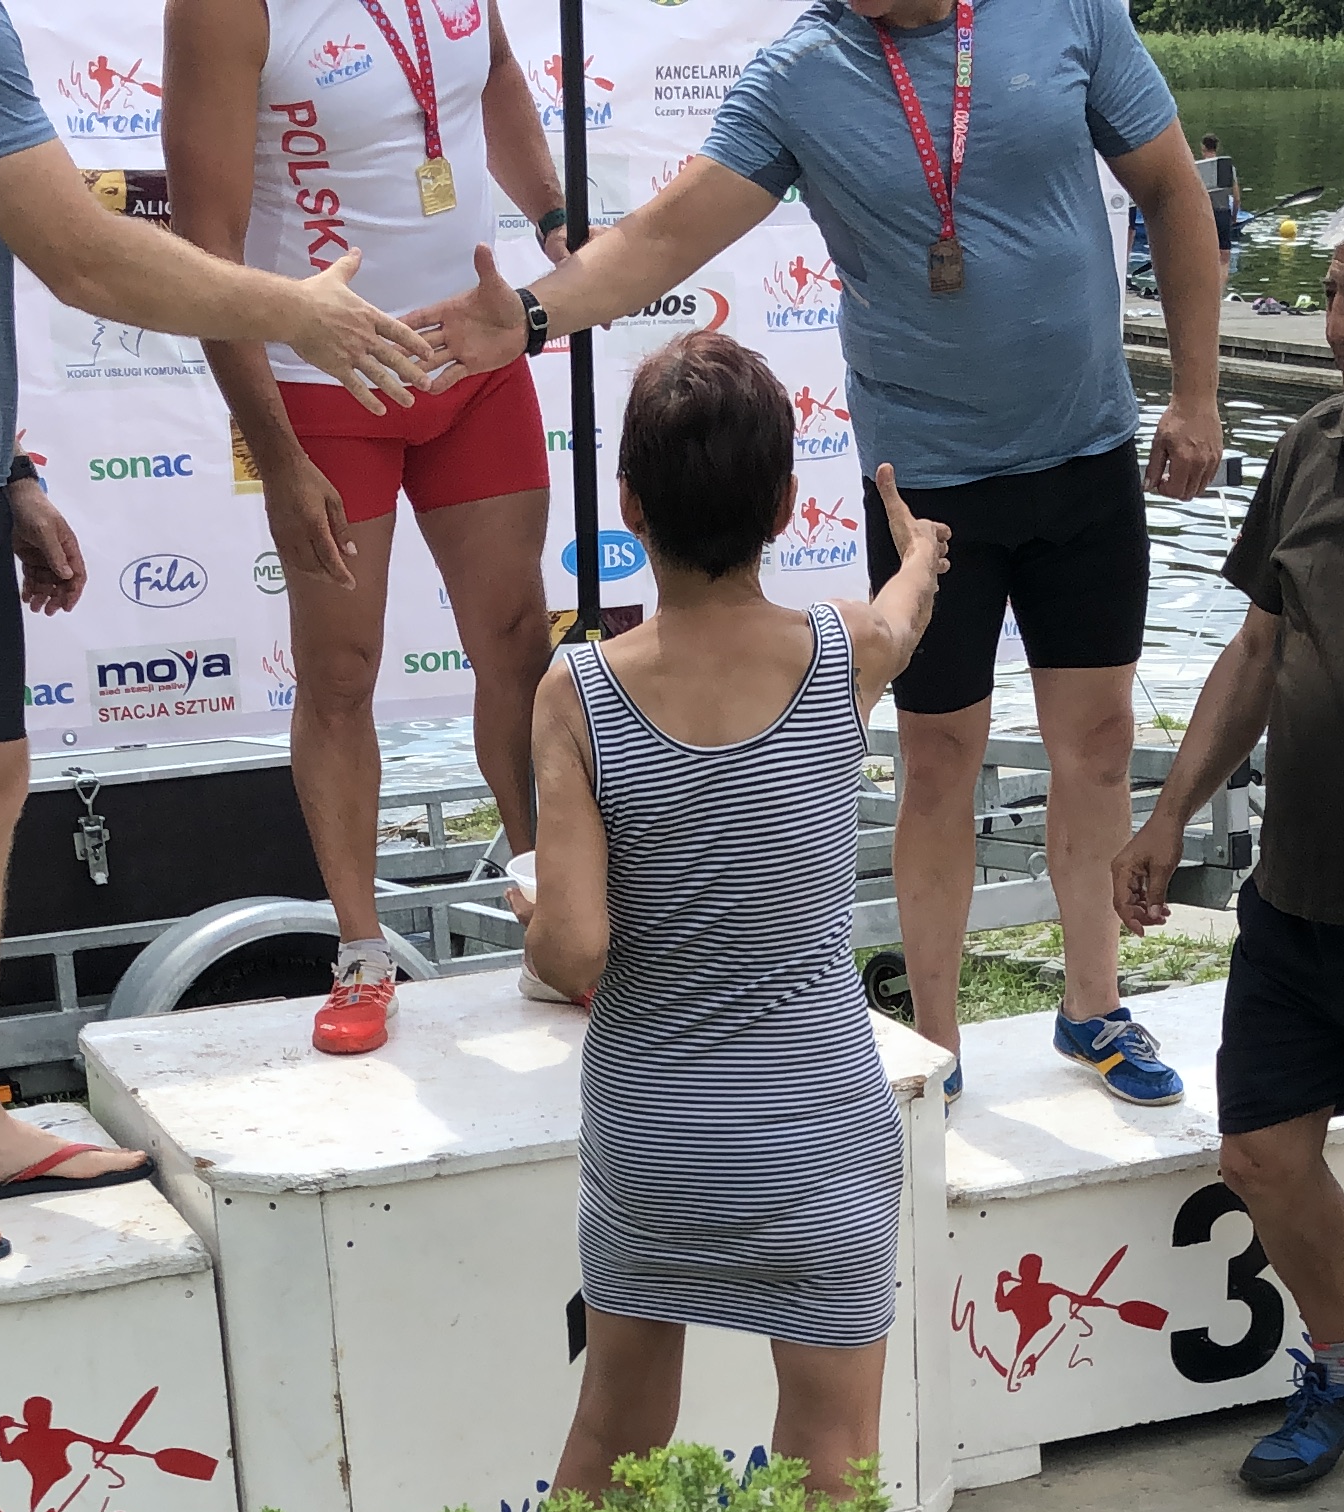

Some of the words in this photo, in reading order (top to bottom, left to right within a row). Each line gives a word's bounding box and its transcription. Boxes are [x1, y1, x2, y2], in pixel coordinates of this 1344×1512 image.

[656, 65, 741, 80] KANCELARIA
[655, 85, 732, 100] NOTARIALN
[67, 369, 101, 379] KOGUT
[144, 366, 205, 376] KOMUNALNE
[90, 454, 192, 481] sonac
[604, 542, 636, 569] BS
[97, 649, 231, 696] moya
[98, 703, 170, 722] STACJA
[174, 696, 235, 716] SZTUM
[1171, 1181, 1285, 1384] 3
